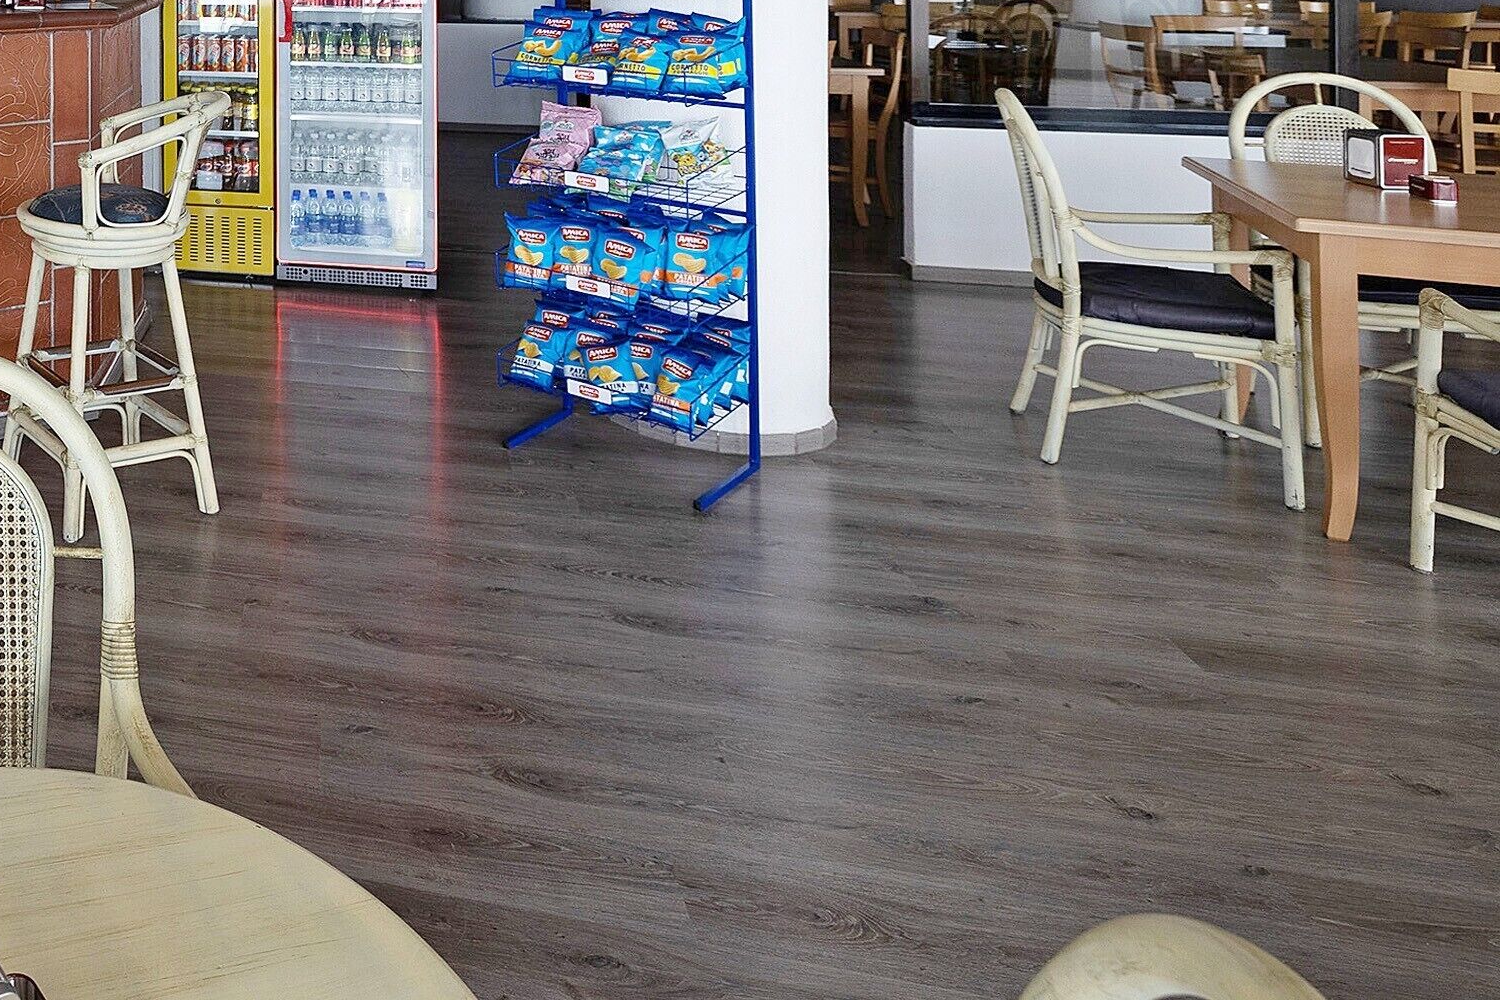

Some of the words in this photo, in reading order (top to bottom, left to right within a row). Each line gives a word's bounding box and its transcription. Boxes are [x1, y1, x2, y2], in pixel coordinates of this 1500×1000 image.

[589, 347, 616, 358] AMICA
[631, 345, 651, 354] MICA
[569, 366, 586, 375] PATA
